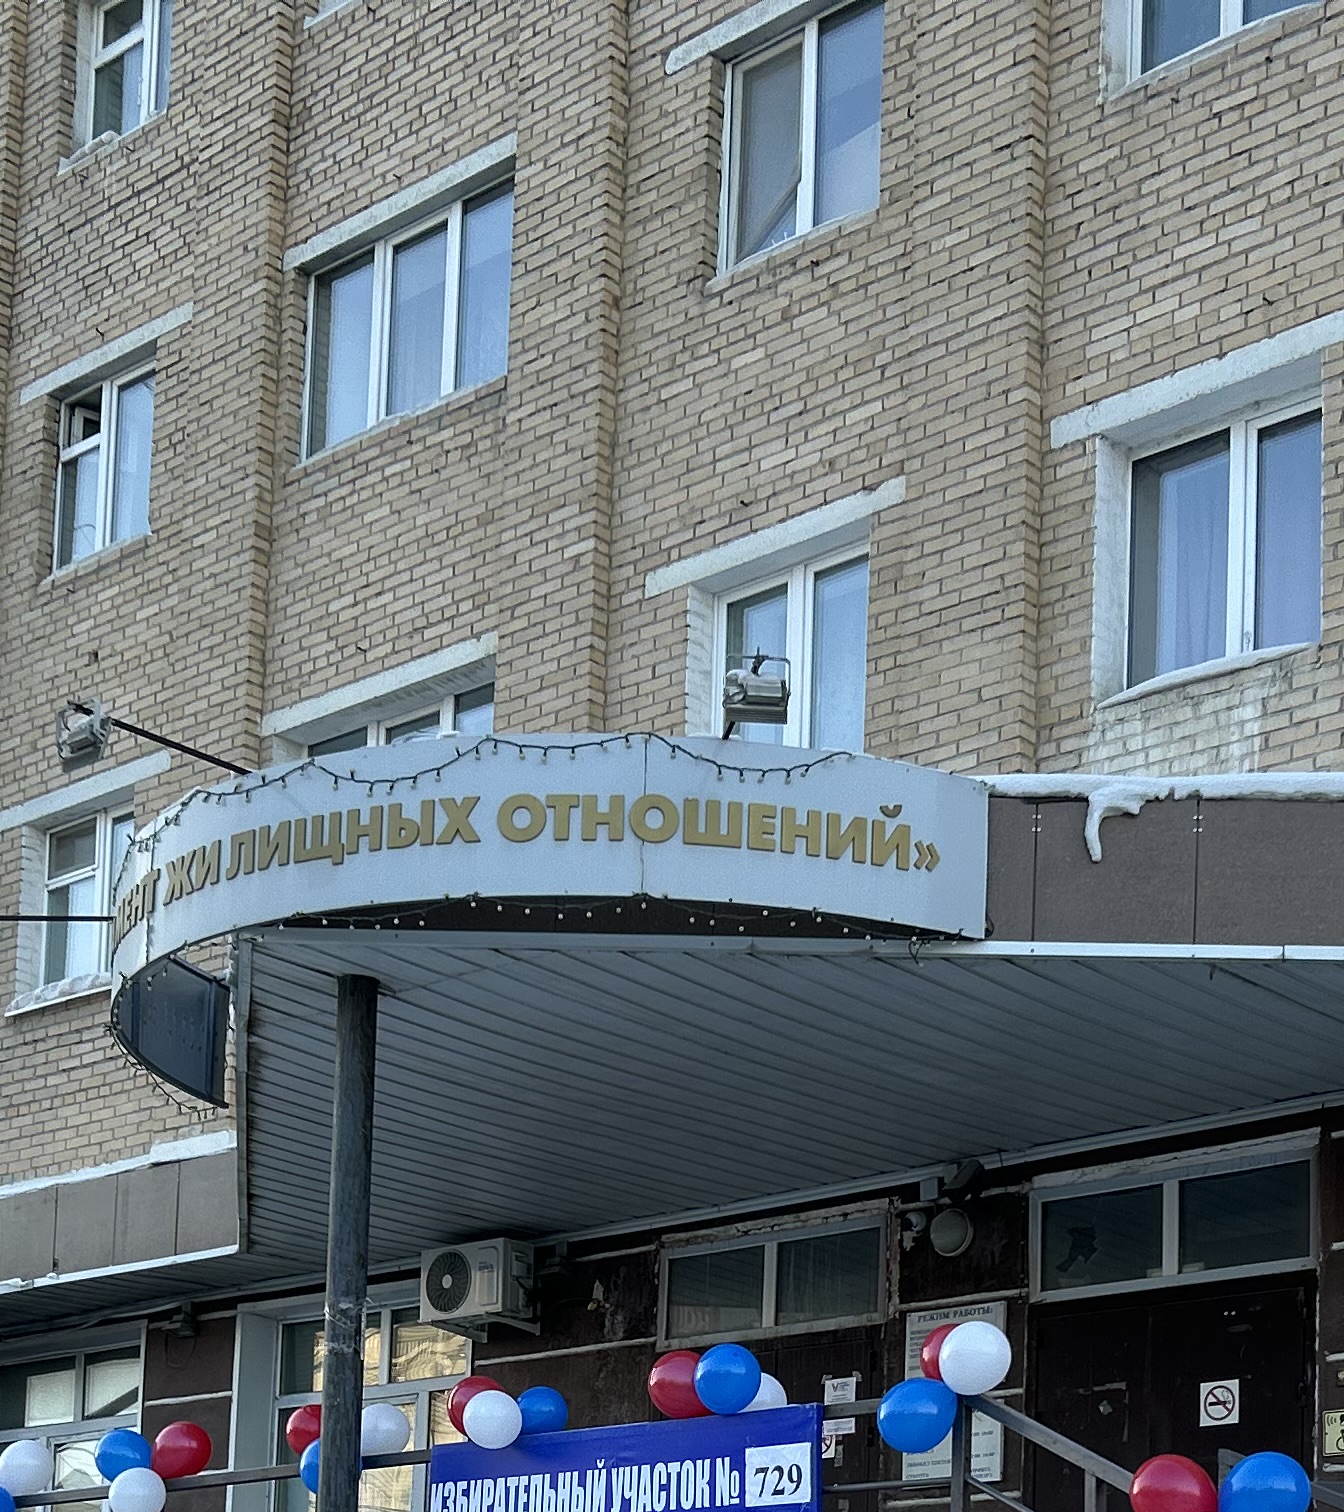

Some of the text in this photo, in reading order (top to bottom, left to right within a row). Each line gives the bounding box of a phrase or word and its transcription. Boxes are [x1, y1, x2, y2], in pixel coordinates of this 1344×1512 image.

[497, 793, 940, 871] ОТНОШЕНИЙ»
[715, 1456, 740, 1506] №
[755, 1463, 804, 1499] 729
